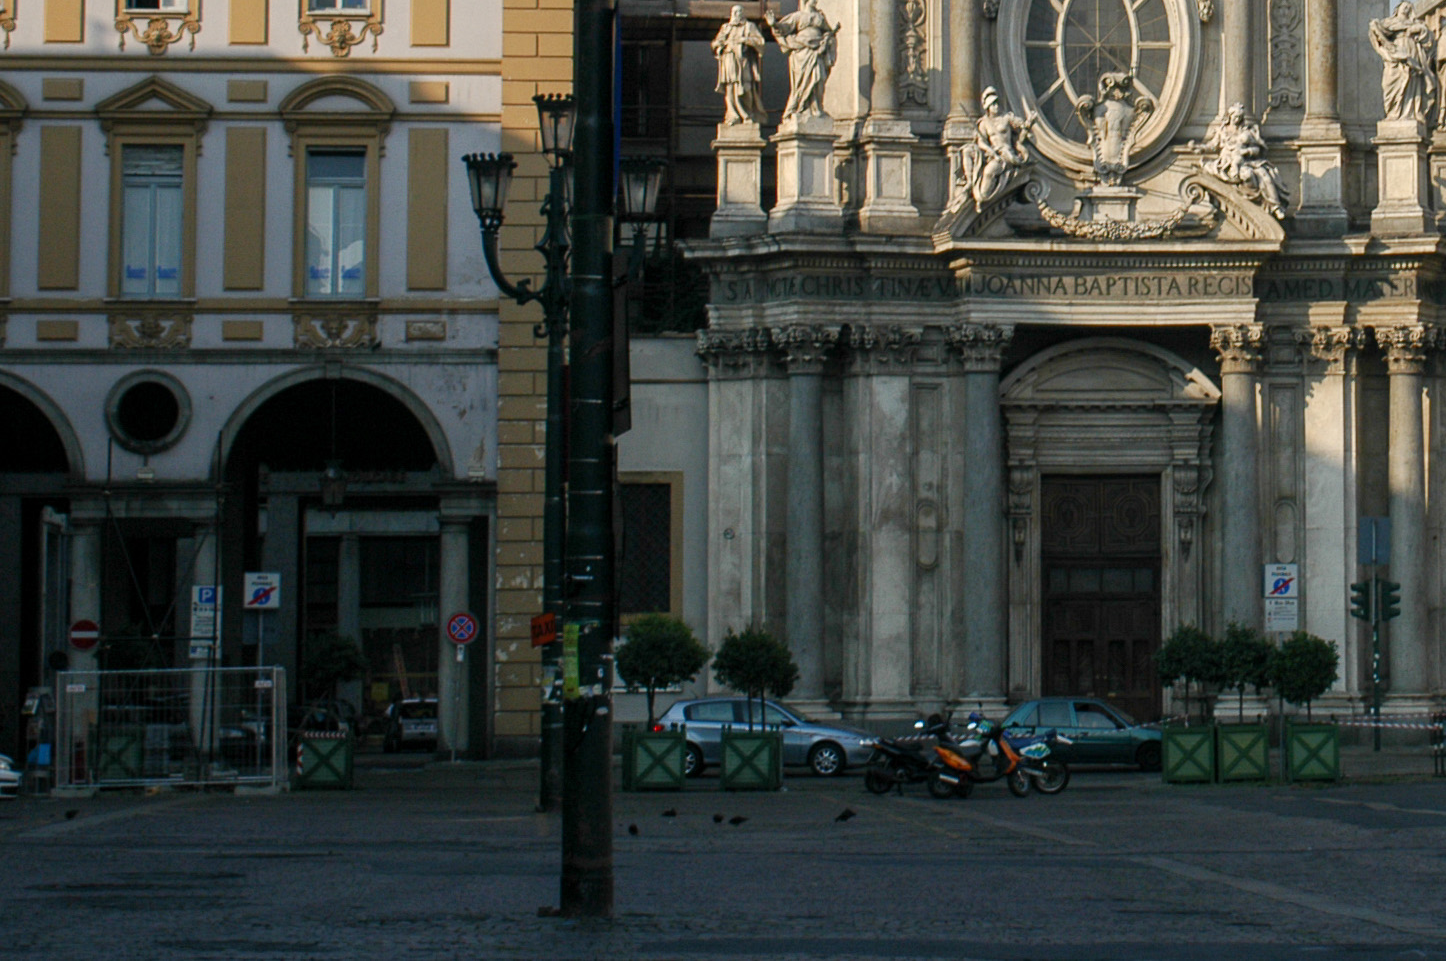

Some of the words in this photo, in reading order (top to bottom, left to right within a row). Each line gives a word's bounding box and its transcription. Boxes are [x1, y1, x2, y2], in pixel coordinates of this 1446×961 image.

[976, 275, 1068, 296] JOANNA
[1073, 276, 1183, 296] BAPTISTA
[1187, 275, 1252, 296] REGIS
[1343, 278, 1416, 299] MATER
